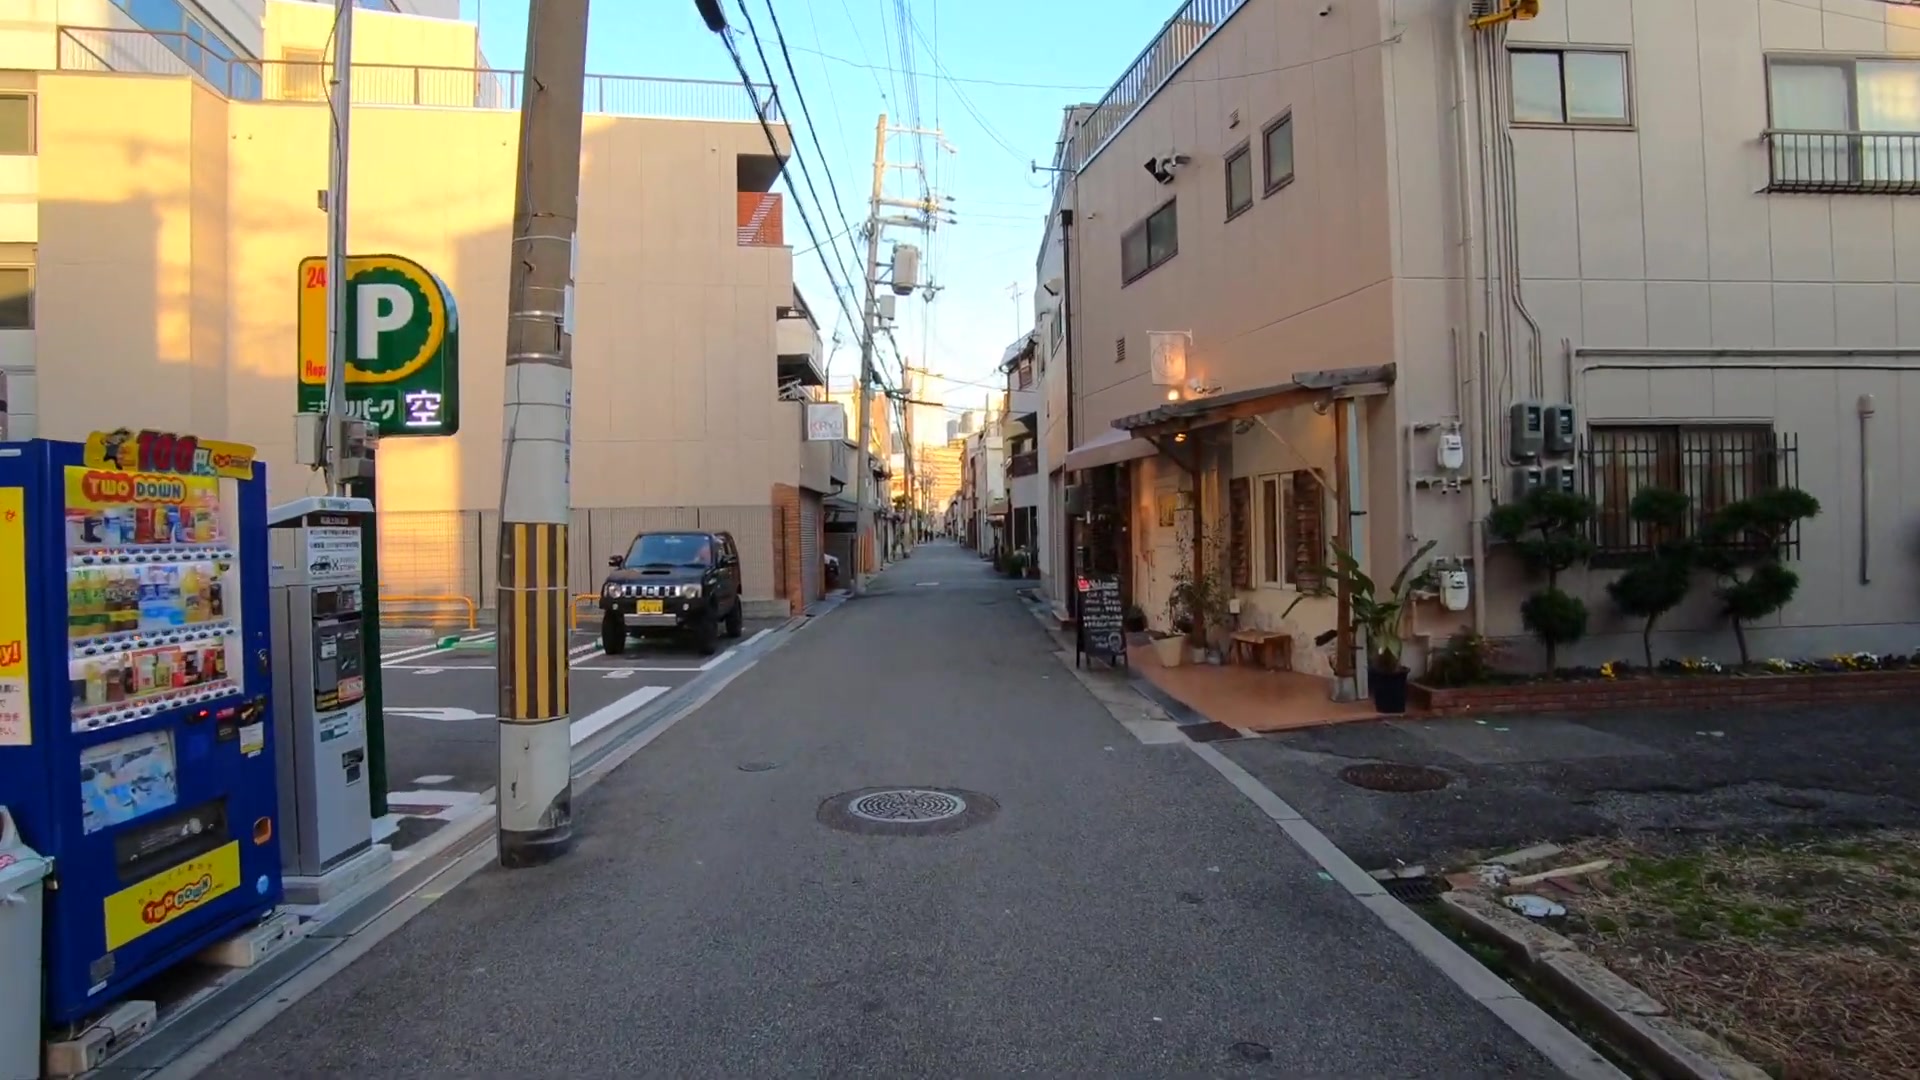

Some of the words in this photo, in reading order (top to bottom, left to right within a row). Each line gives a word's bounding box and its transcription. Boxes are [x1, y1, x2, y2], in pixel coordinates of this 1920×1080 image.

[356, 283, 414, 360] P
[405, 390, 442, 426] 空
[88, 475, 131, 496] TWO
[136, 482, 182, 498] DOWN
